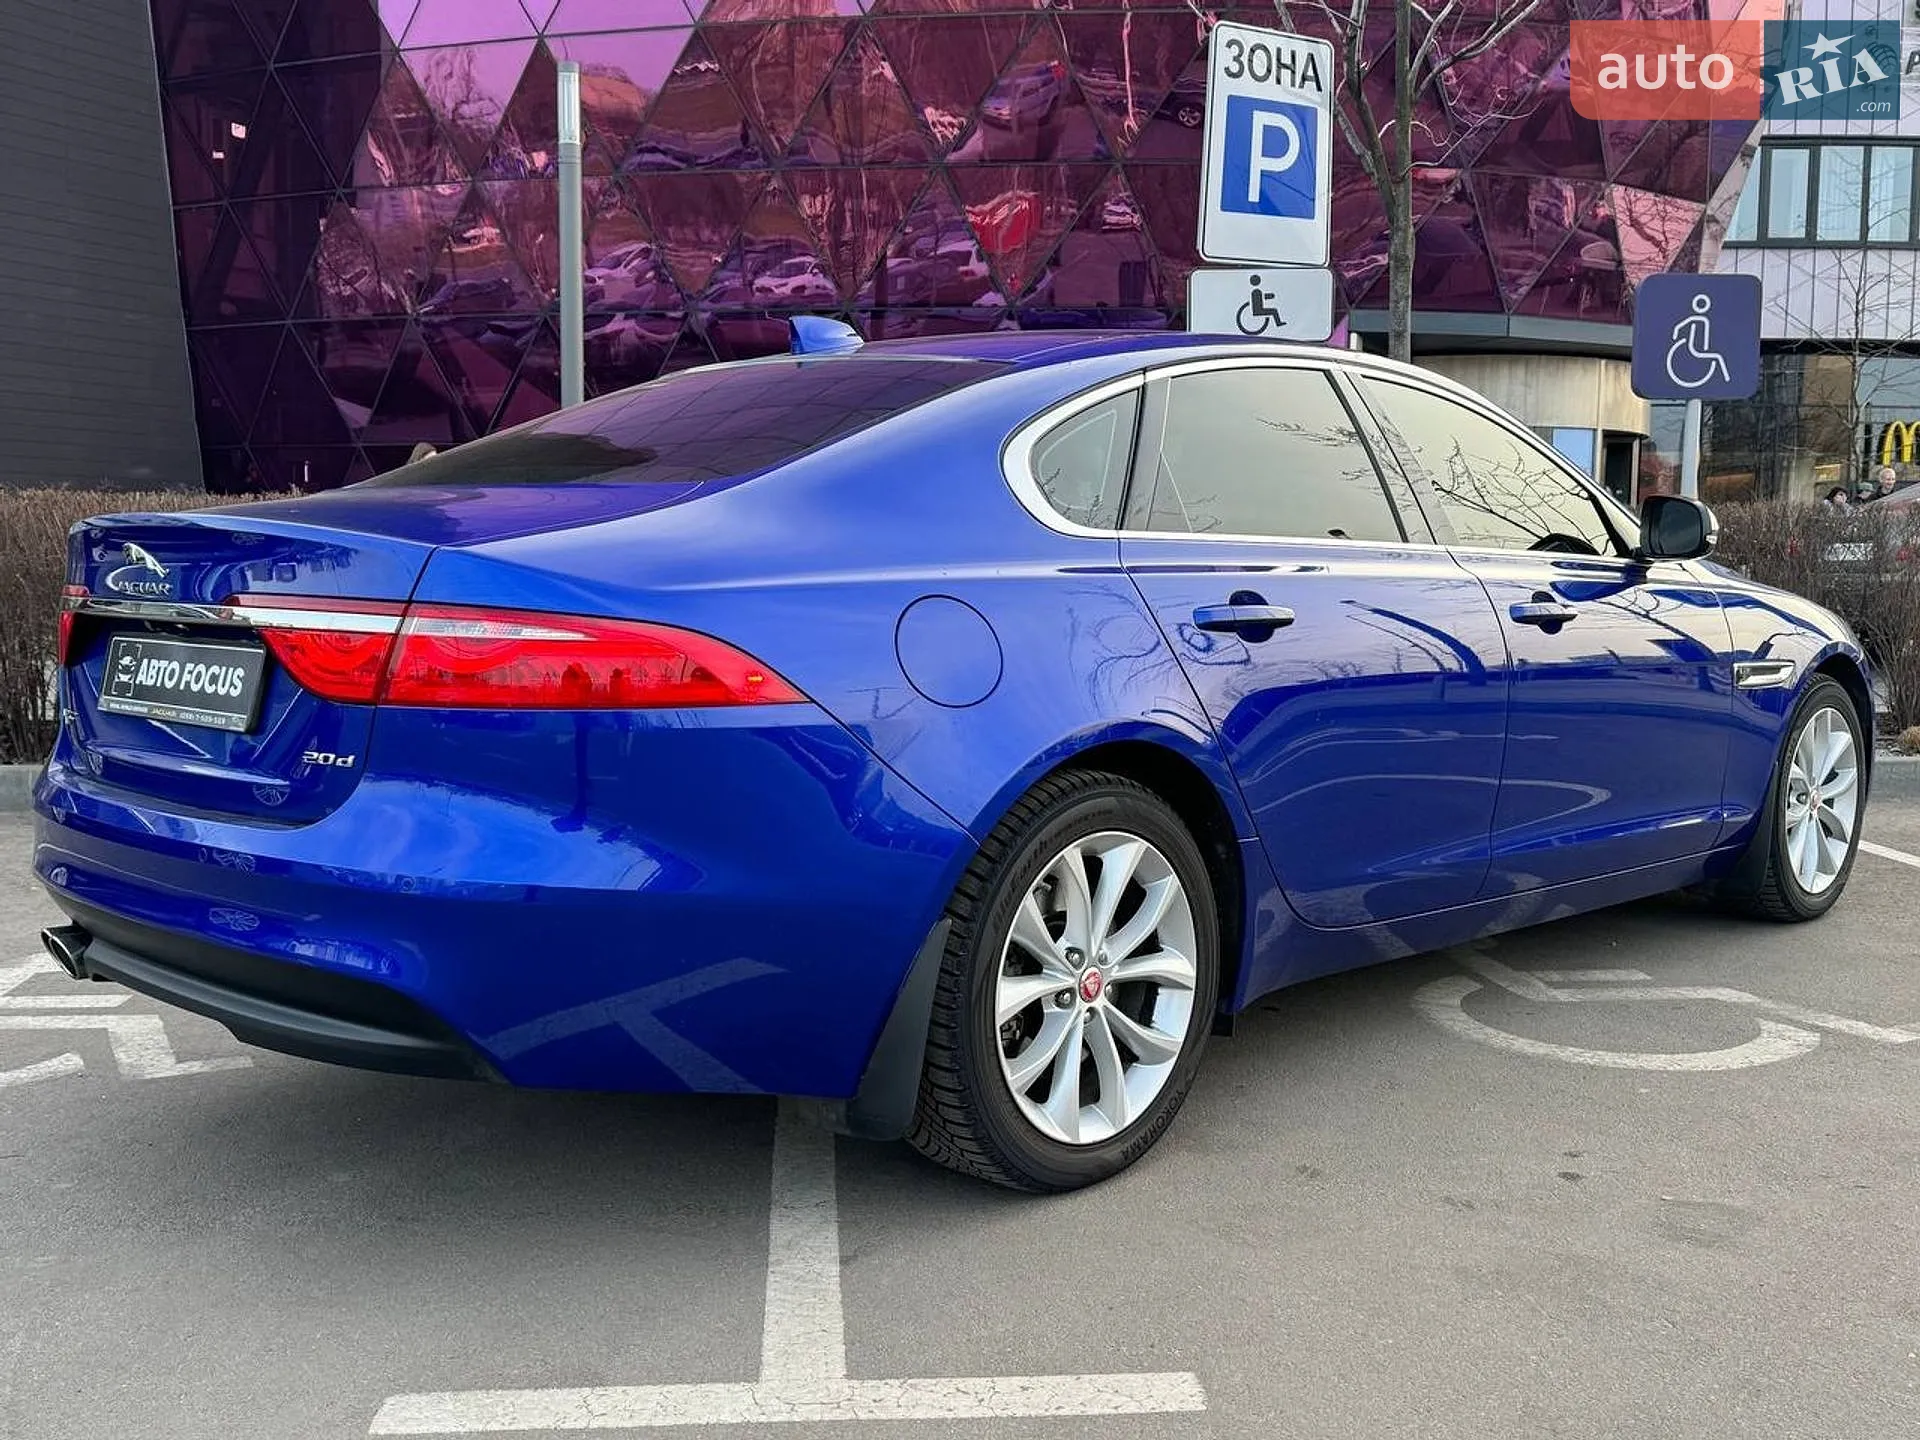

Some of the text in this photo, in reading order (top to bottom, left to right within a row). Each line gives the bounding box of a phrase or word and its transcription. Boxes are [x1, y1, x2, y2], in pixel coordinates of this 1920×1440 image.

[1224, 38, 1322, 93] ЗОНА
[1248, 109, 1300, 203] P
[117, 580, 172, 597] JAGUAR
[135, 658, 245, 697] АВТО FOCUS
[302, 750, 355, 768] 20d
[1120, 1089, 1185, 1162] YOKOHAMA
